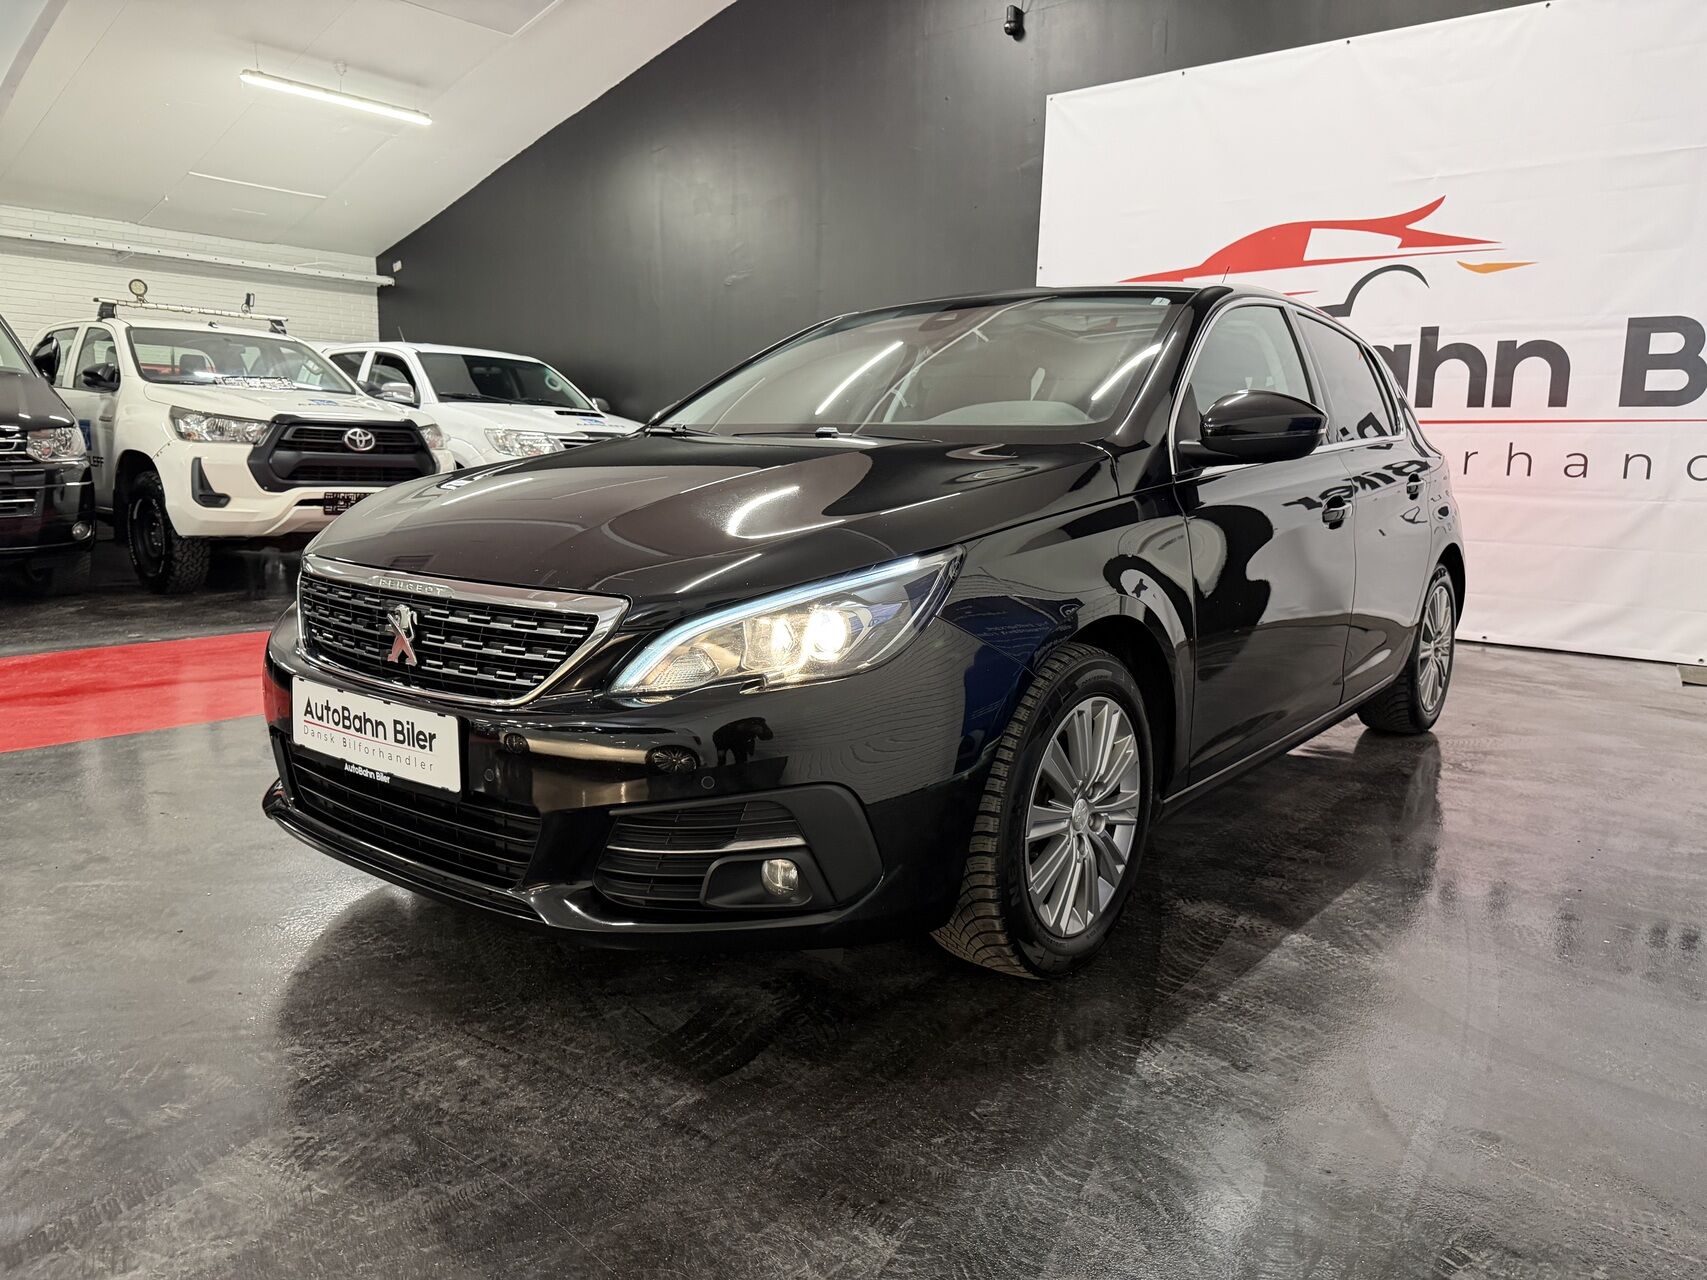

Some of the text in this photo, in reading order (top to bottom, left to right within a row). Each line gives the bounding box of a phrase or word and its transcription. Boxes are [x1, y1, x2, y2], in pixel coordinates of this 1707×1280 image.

[379, 578, 444, 596] PEUGEOT
[303, 696, 437, 752] AutoBahn Biler
[303, 725, 434, 772] Dansk Bilforhandler
[344, 762, 391, 784] AutoBahn Biler
